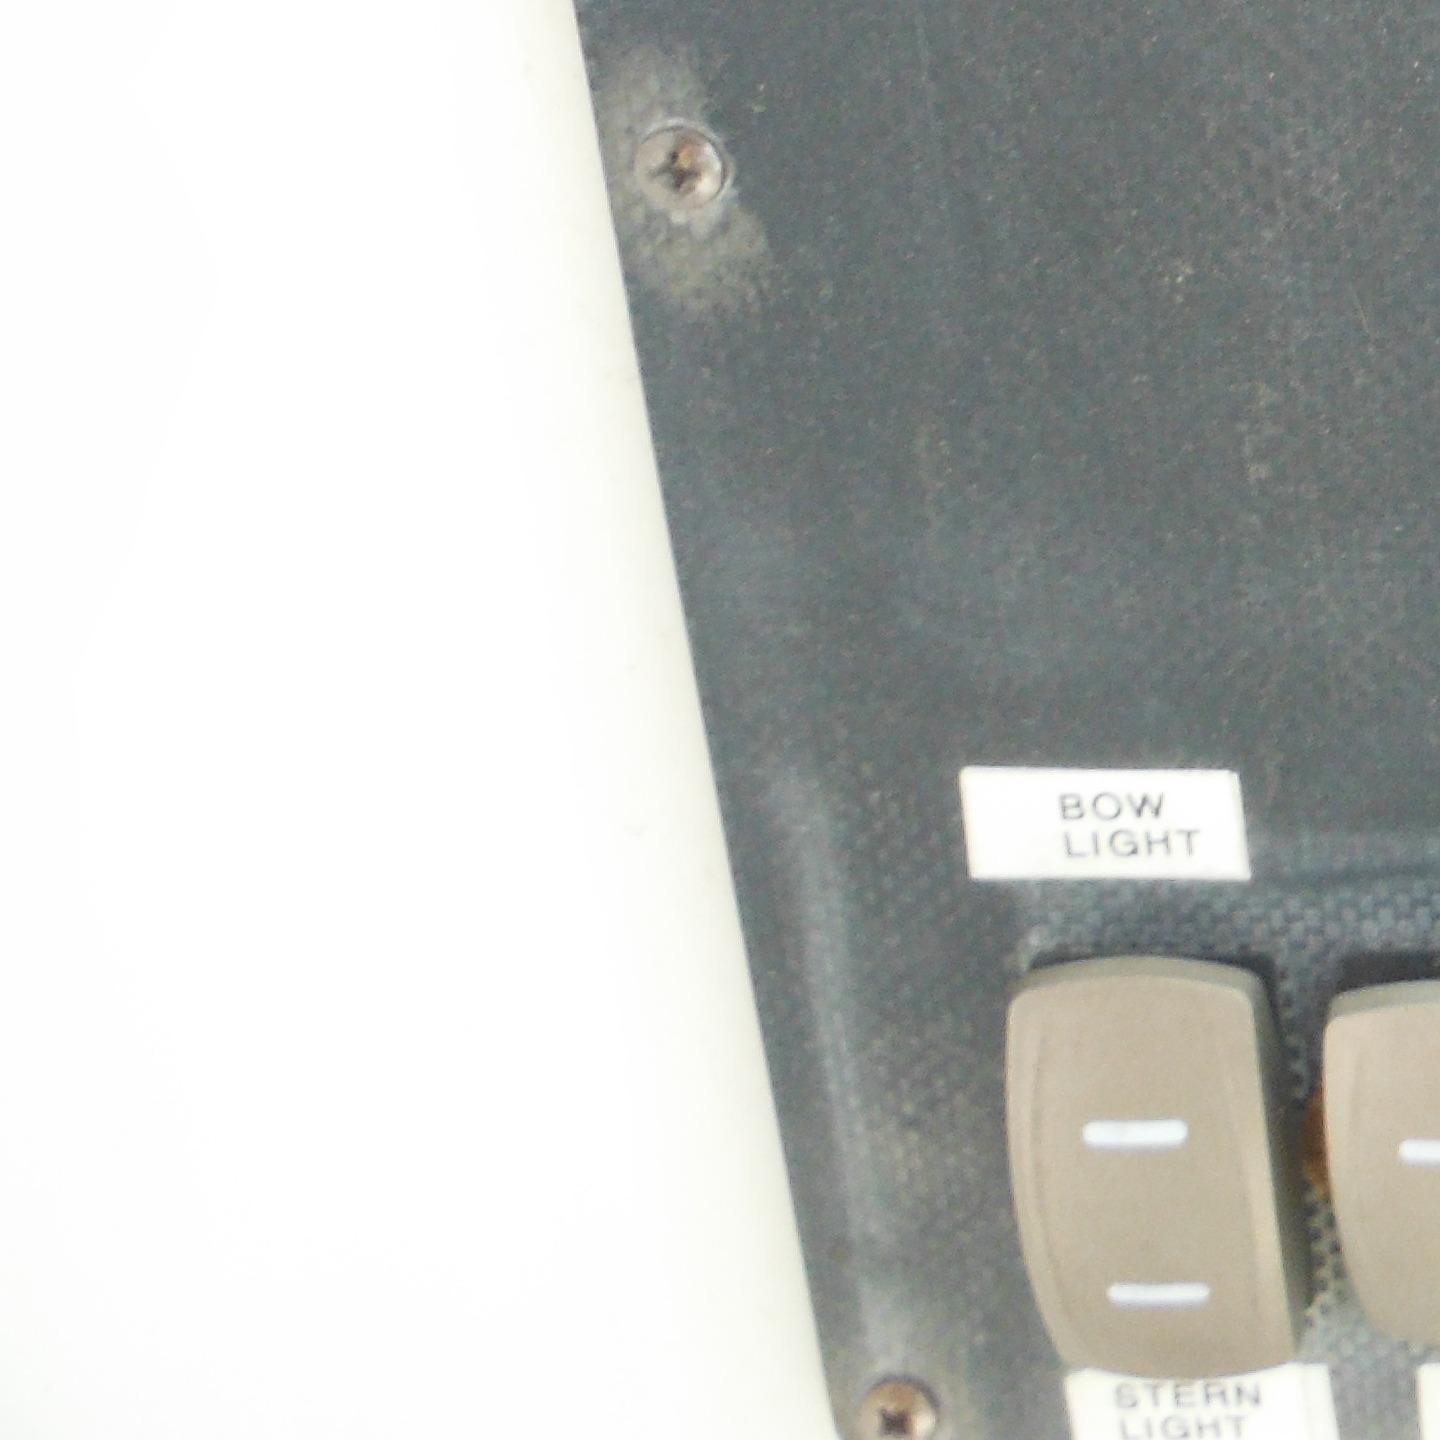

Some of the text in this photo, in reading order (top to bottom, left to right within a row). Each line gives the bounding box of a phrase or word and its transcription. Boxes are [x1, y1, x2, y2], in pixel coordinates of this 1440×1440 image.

[1059, 792, 1164, 821] BOW
[1064, 828, 1201, 858] LIGHT
[1114, 1380, 1262, 1409] STERN
[1119, 1413, 1250, 1440] LIGHT
